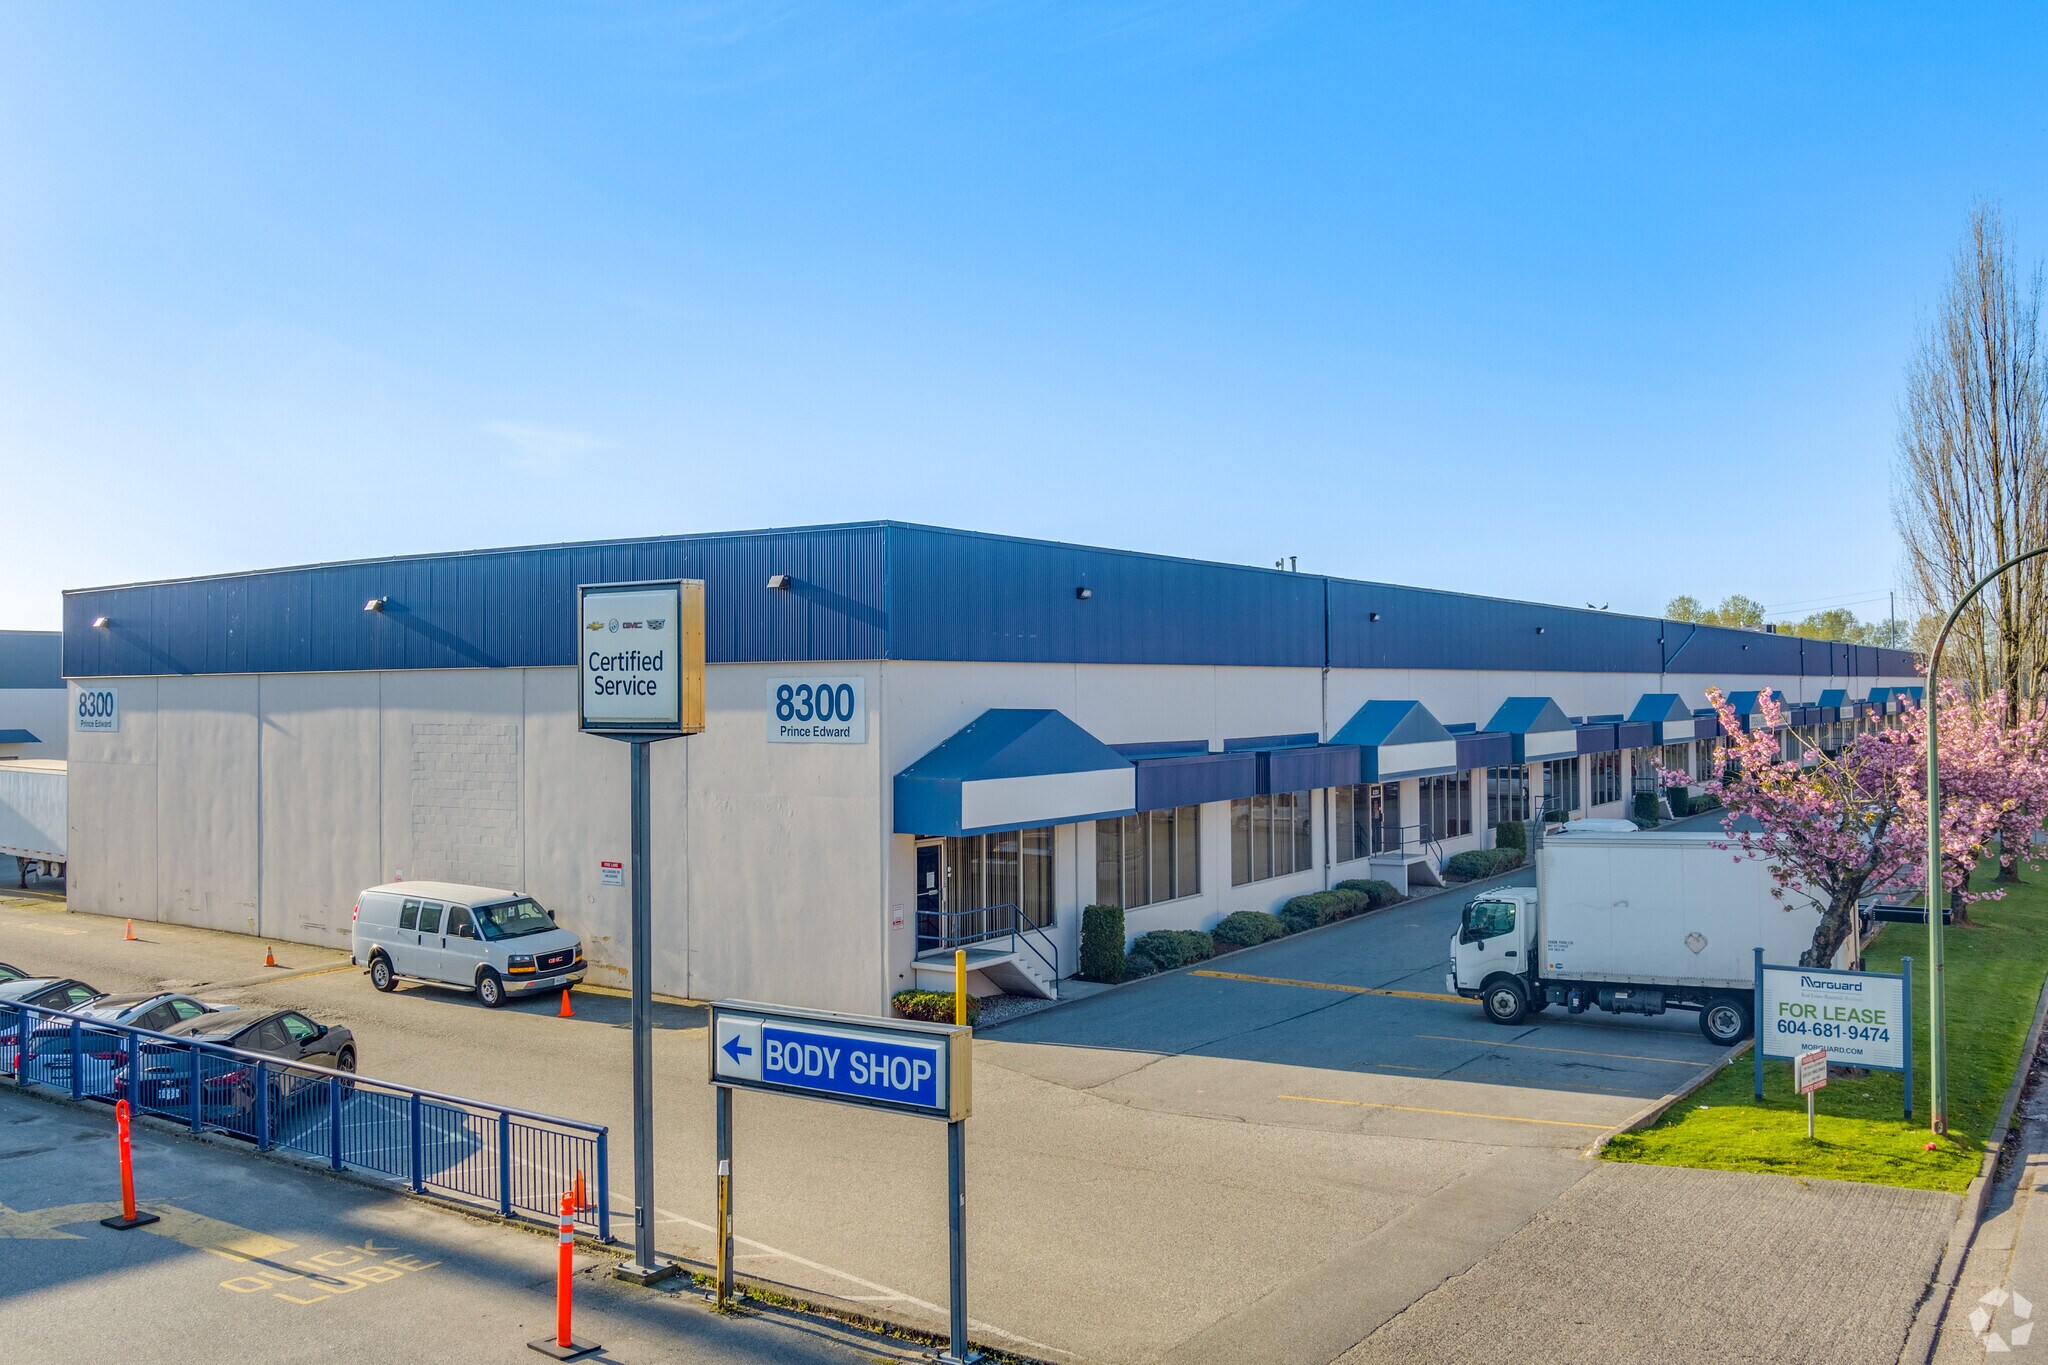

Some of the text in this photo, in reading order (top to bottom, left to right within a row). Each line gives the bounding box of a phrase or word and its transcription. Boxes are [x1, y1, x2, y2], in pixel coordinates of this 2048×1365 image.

[622, 621, 643, 629] GMC
[588, 649, 663, 672] Certified
[594, 674, 657, 696] Service
[79, 691, 113, 718] 8300
[775, 683, 855, 722] 8300
[80, 719, 112, 728] Prince Edward
[780, 725, 850, 738] Prince Edward
[1801, 975, 1863, 992] Morguard
[1778, 1001, 1887, 1026] FOR LEASE
[1777, 1019, 1890, 1043] 604-681-9474
[766, 1039, 932, 1092] BODY SHOP
[272, 1254, 443, 1305] LUBE
